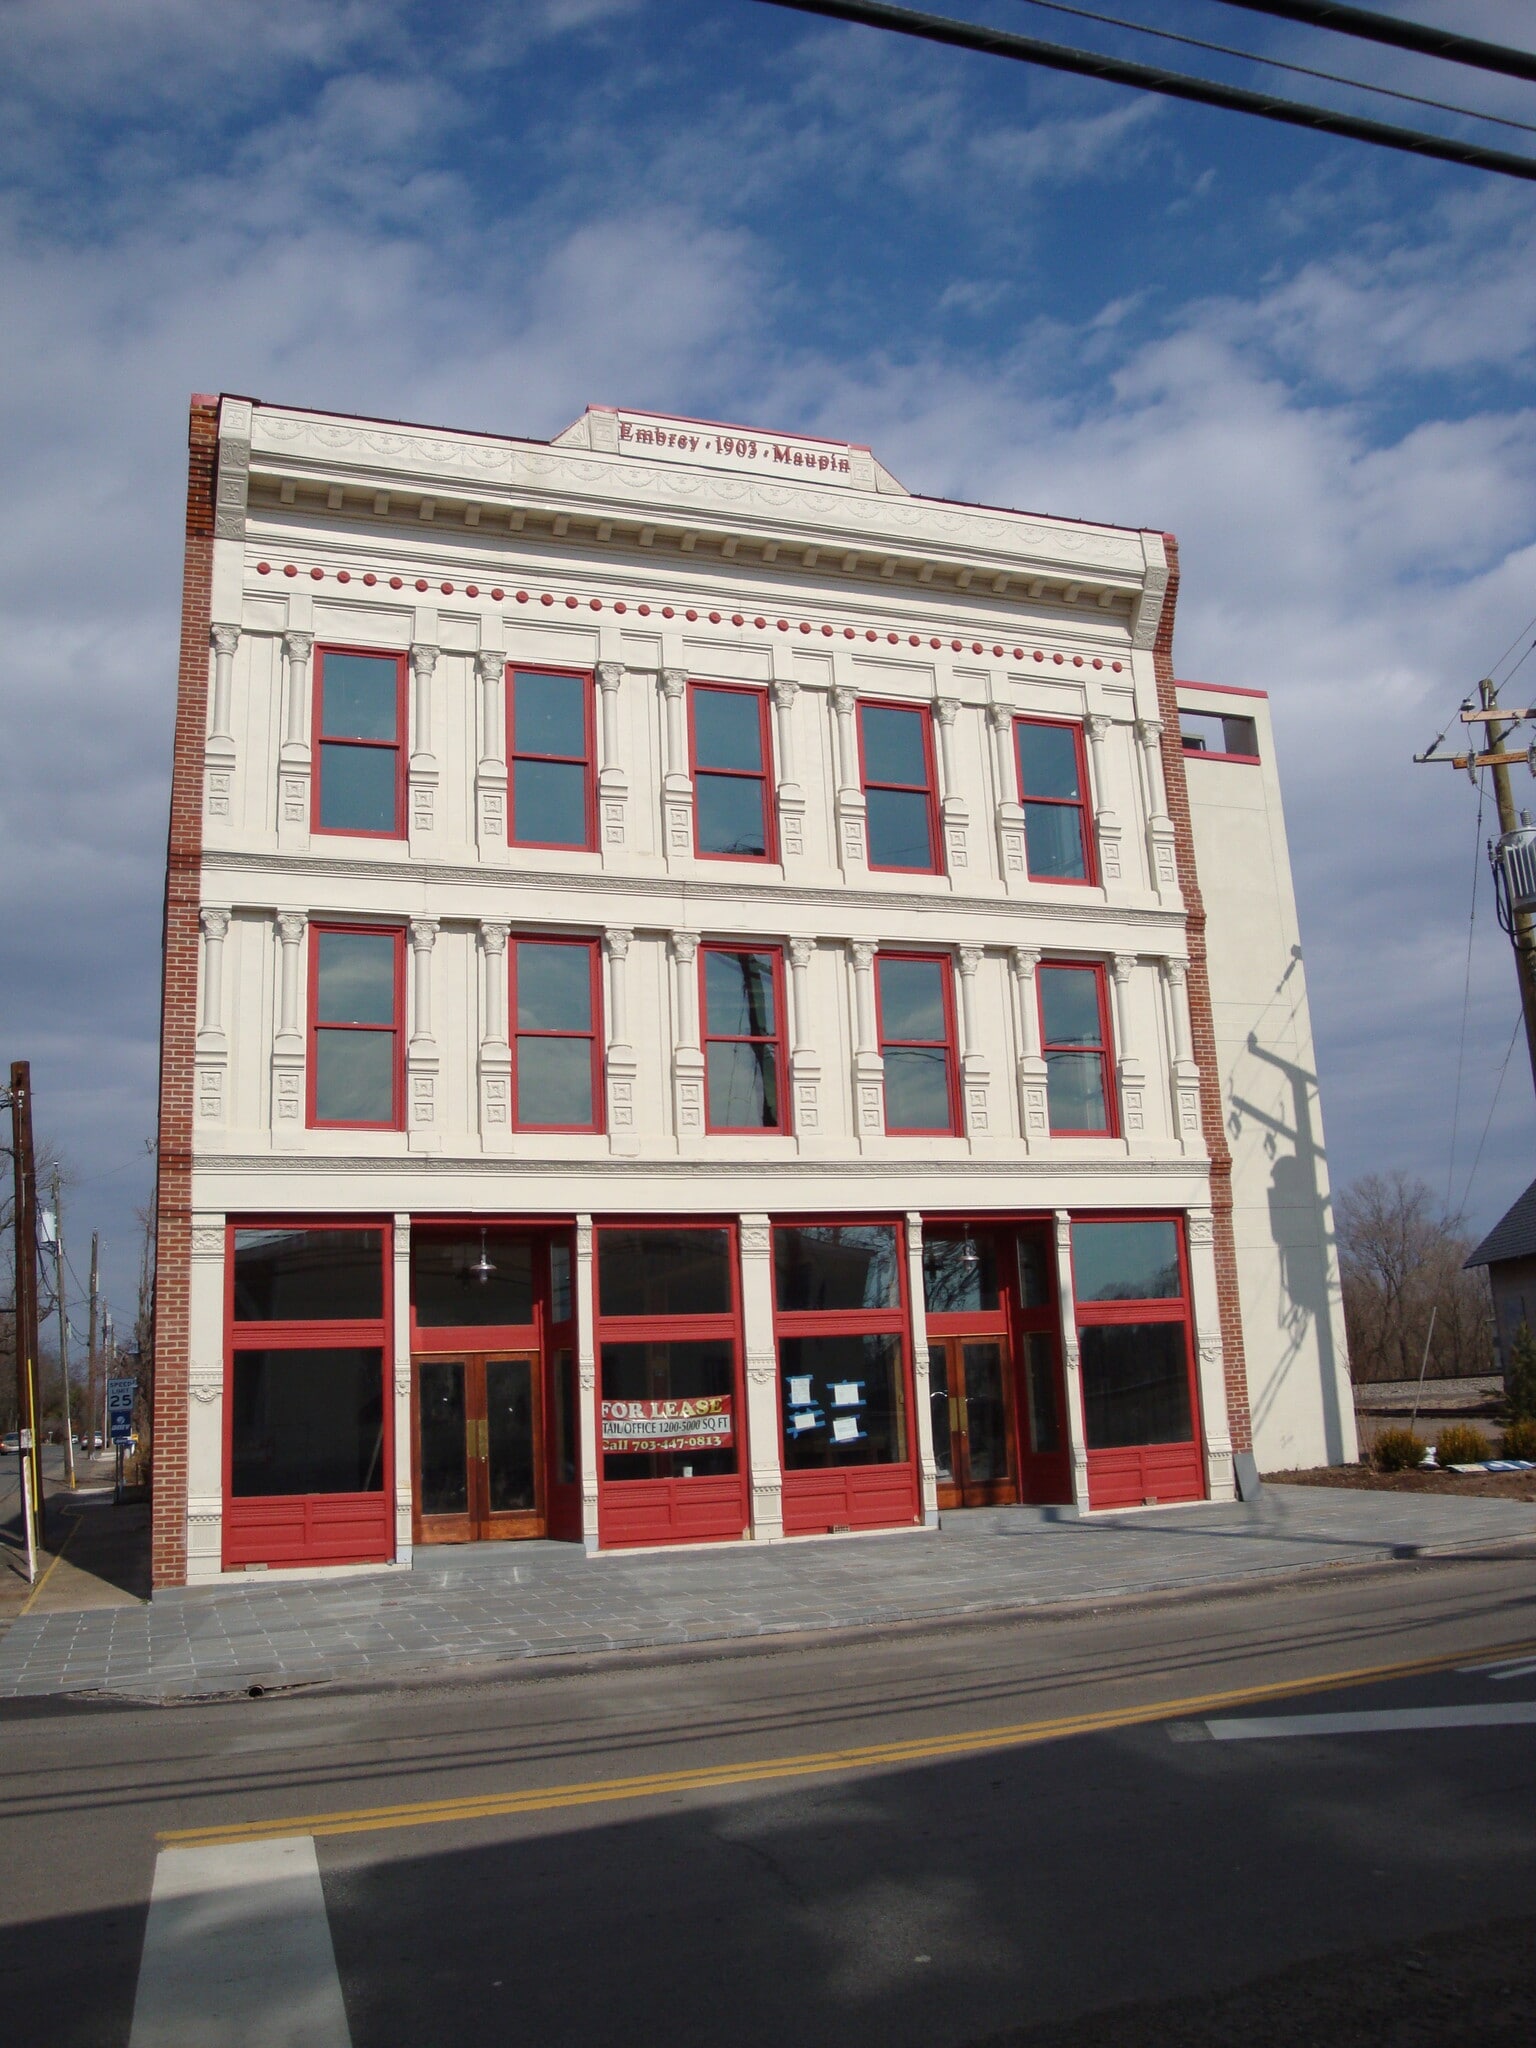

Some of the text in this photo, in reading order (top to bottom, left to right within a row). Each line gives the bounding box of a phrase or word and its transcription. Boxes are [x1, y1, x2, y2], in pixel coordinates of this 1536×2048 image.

[620, 421, 850, 473] Embrey 1903 Maupin
[110, 1395, 132, 1407] 25
[601, 1398, 722, 1418] FOR LEASE
[659, 1420, 701, 1433] 1200-5000
[702, 1417, 716, 1431] SQ
[718, 1417, 728, 1428] FT
[602, 1436, 722, 1451] Call 703-447-0813
